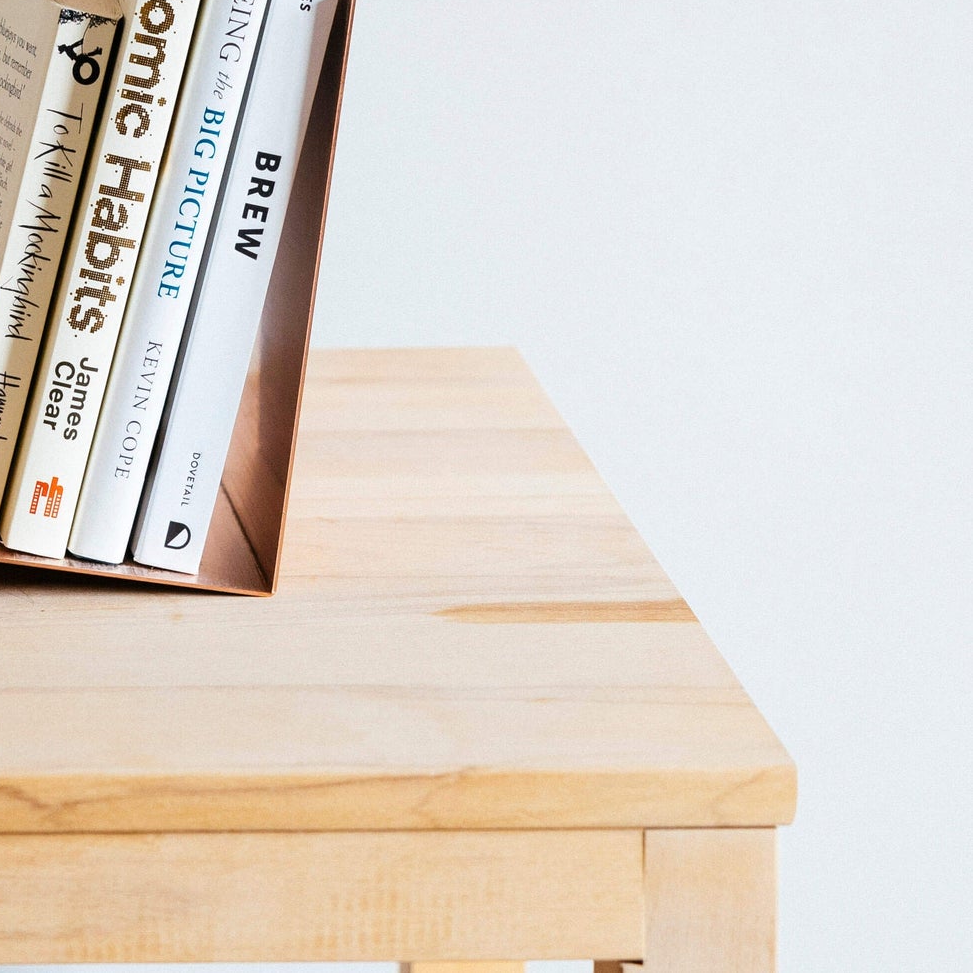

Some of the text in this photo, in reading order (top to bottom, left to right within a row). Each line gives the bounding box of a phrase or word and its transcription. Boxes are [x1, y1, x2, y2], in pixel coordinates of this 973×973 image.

[2, 46, 11, 66] but
[10, 59, 32, 79] remember
[16, 36, 26, 49] you
[213, 71, 233, 100] the
[193, 106, 226, 160] BIG
[0, 102, 84, 342] To Kill a Mockingbird
[68, 153, 152, 334] Habits
[157, 167, 210, 299] PICTURE
[234, 150, 282, 261] BREW
[42, 360, 76, 432] Clear
[63, 357, 99, 442] James
[114, 340, 164, 480] KEVIN COPE
[180, 451, 202, 507] DOVETAIL
